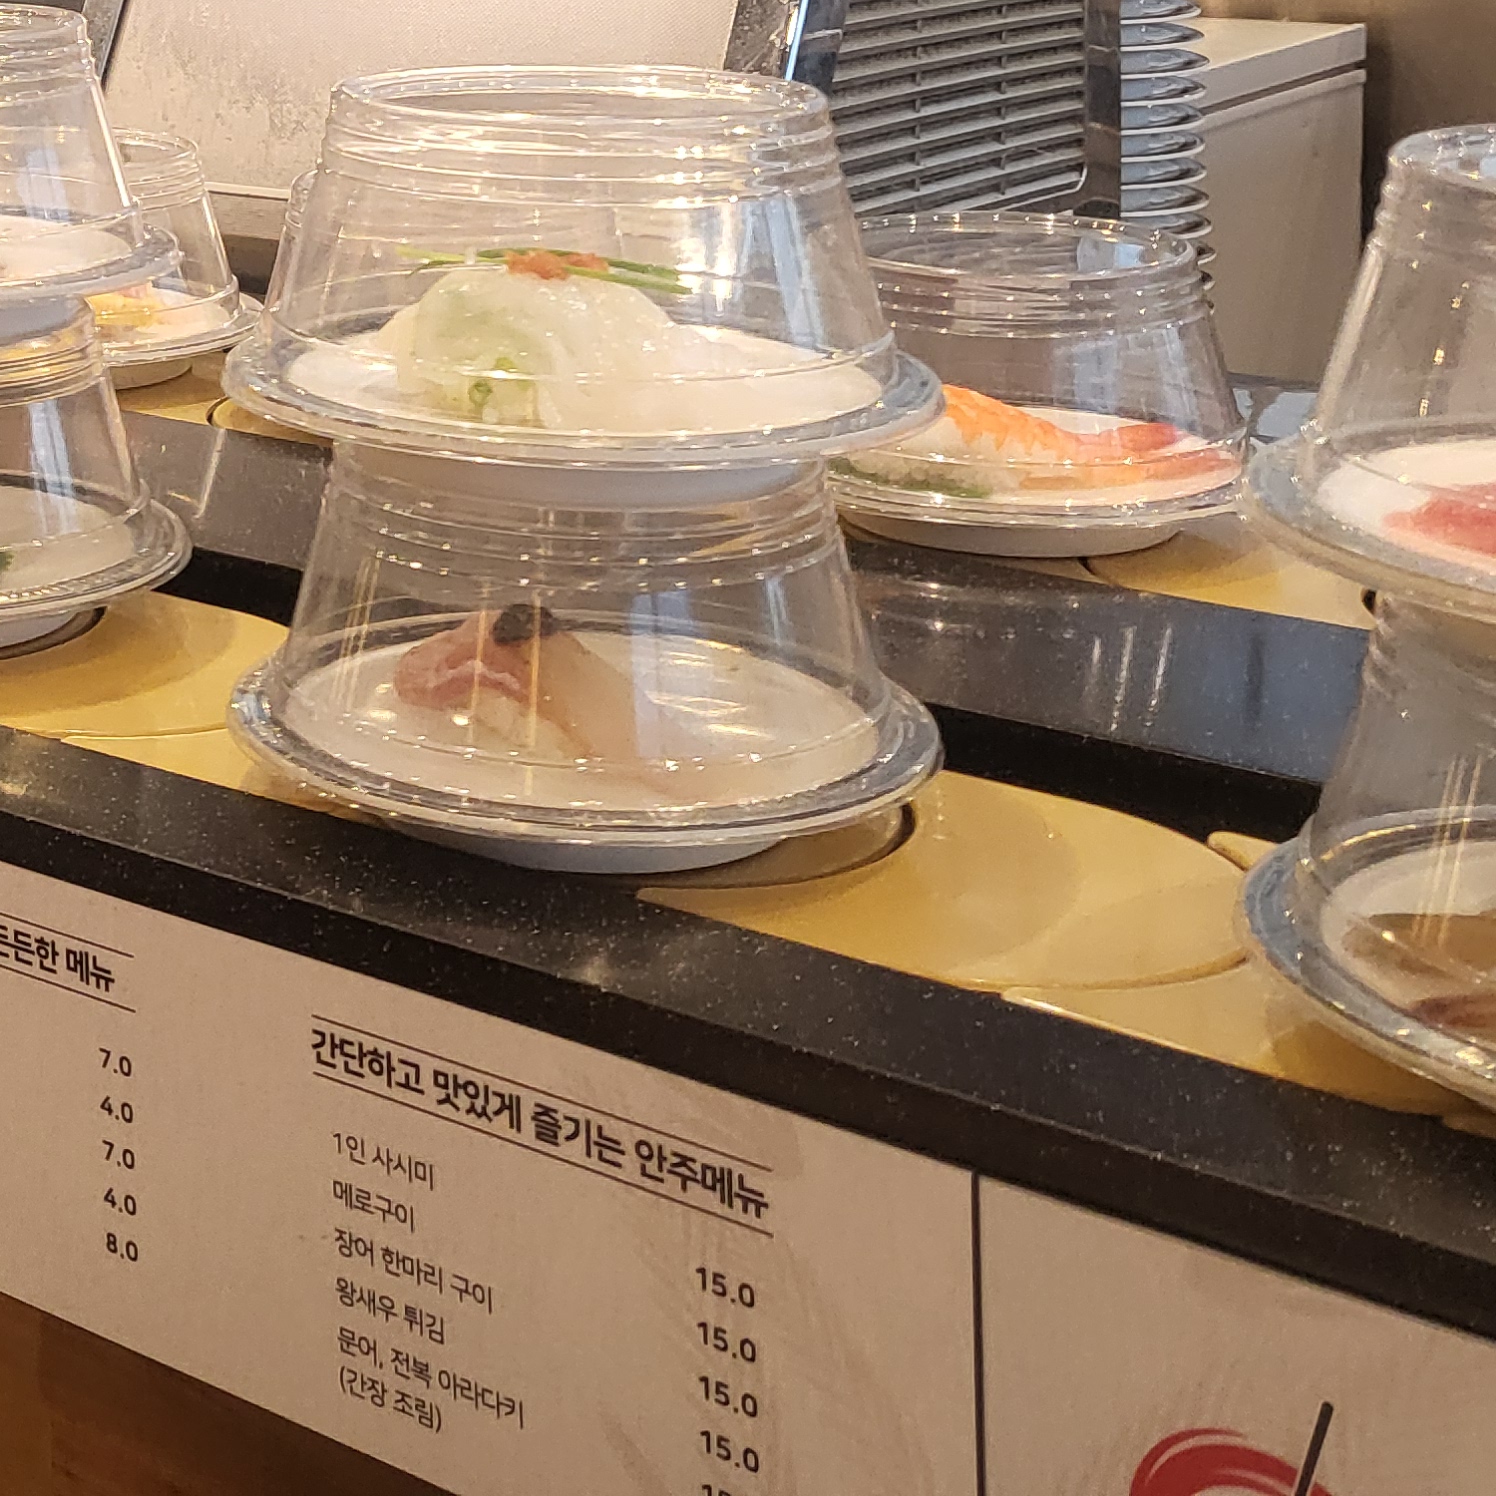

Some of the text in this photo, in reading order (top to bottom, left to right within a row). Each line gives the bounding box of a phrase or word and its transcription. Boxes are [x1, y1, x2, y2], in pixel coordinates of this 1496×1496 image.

[66, 948, 115, 992] 메뉴
[99, 1048, 132, 1077] 7.0
[100, 1096, 133, 1123] 4.0
[311, 1029, 769, 1219] 간단하고 맛있게 즐기는 안주메뉴
[102, 1140, 135, 1169] 7.0
[333, 1133, 433, 1191] 1인 사시미
[104, 1188, 136, 1216] 4.0
[333, 1181, 414, 1233] 메로구이
[106, 1232, 138, 1262] 8.0
[335, 1228, 492, 1314] 장어 한마리 구이
[696, 1267, 754, 1308] 15.0
[336, 1278, 444, 1345] 왕새우 튀김
[697, 1322, 756, 1363] 15.0
[338, 1327, 523, 1429] 문어, 전복 아라다키
[340, 1366, 441, 1433] (간장 조림)
[699, 1376, 758, 1418] 15.0
[700, 1430, 759, 1473] 15.0
